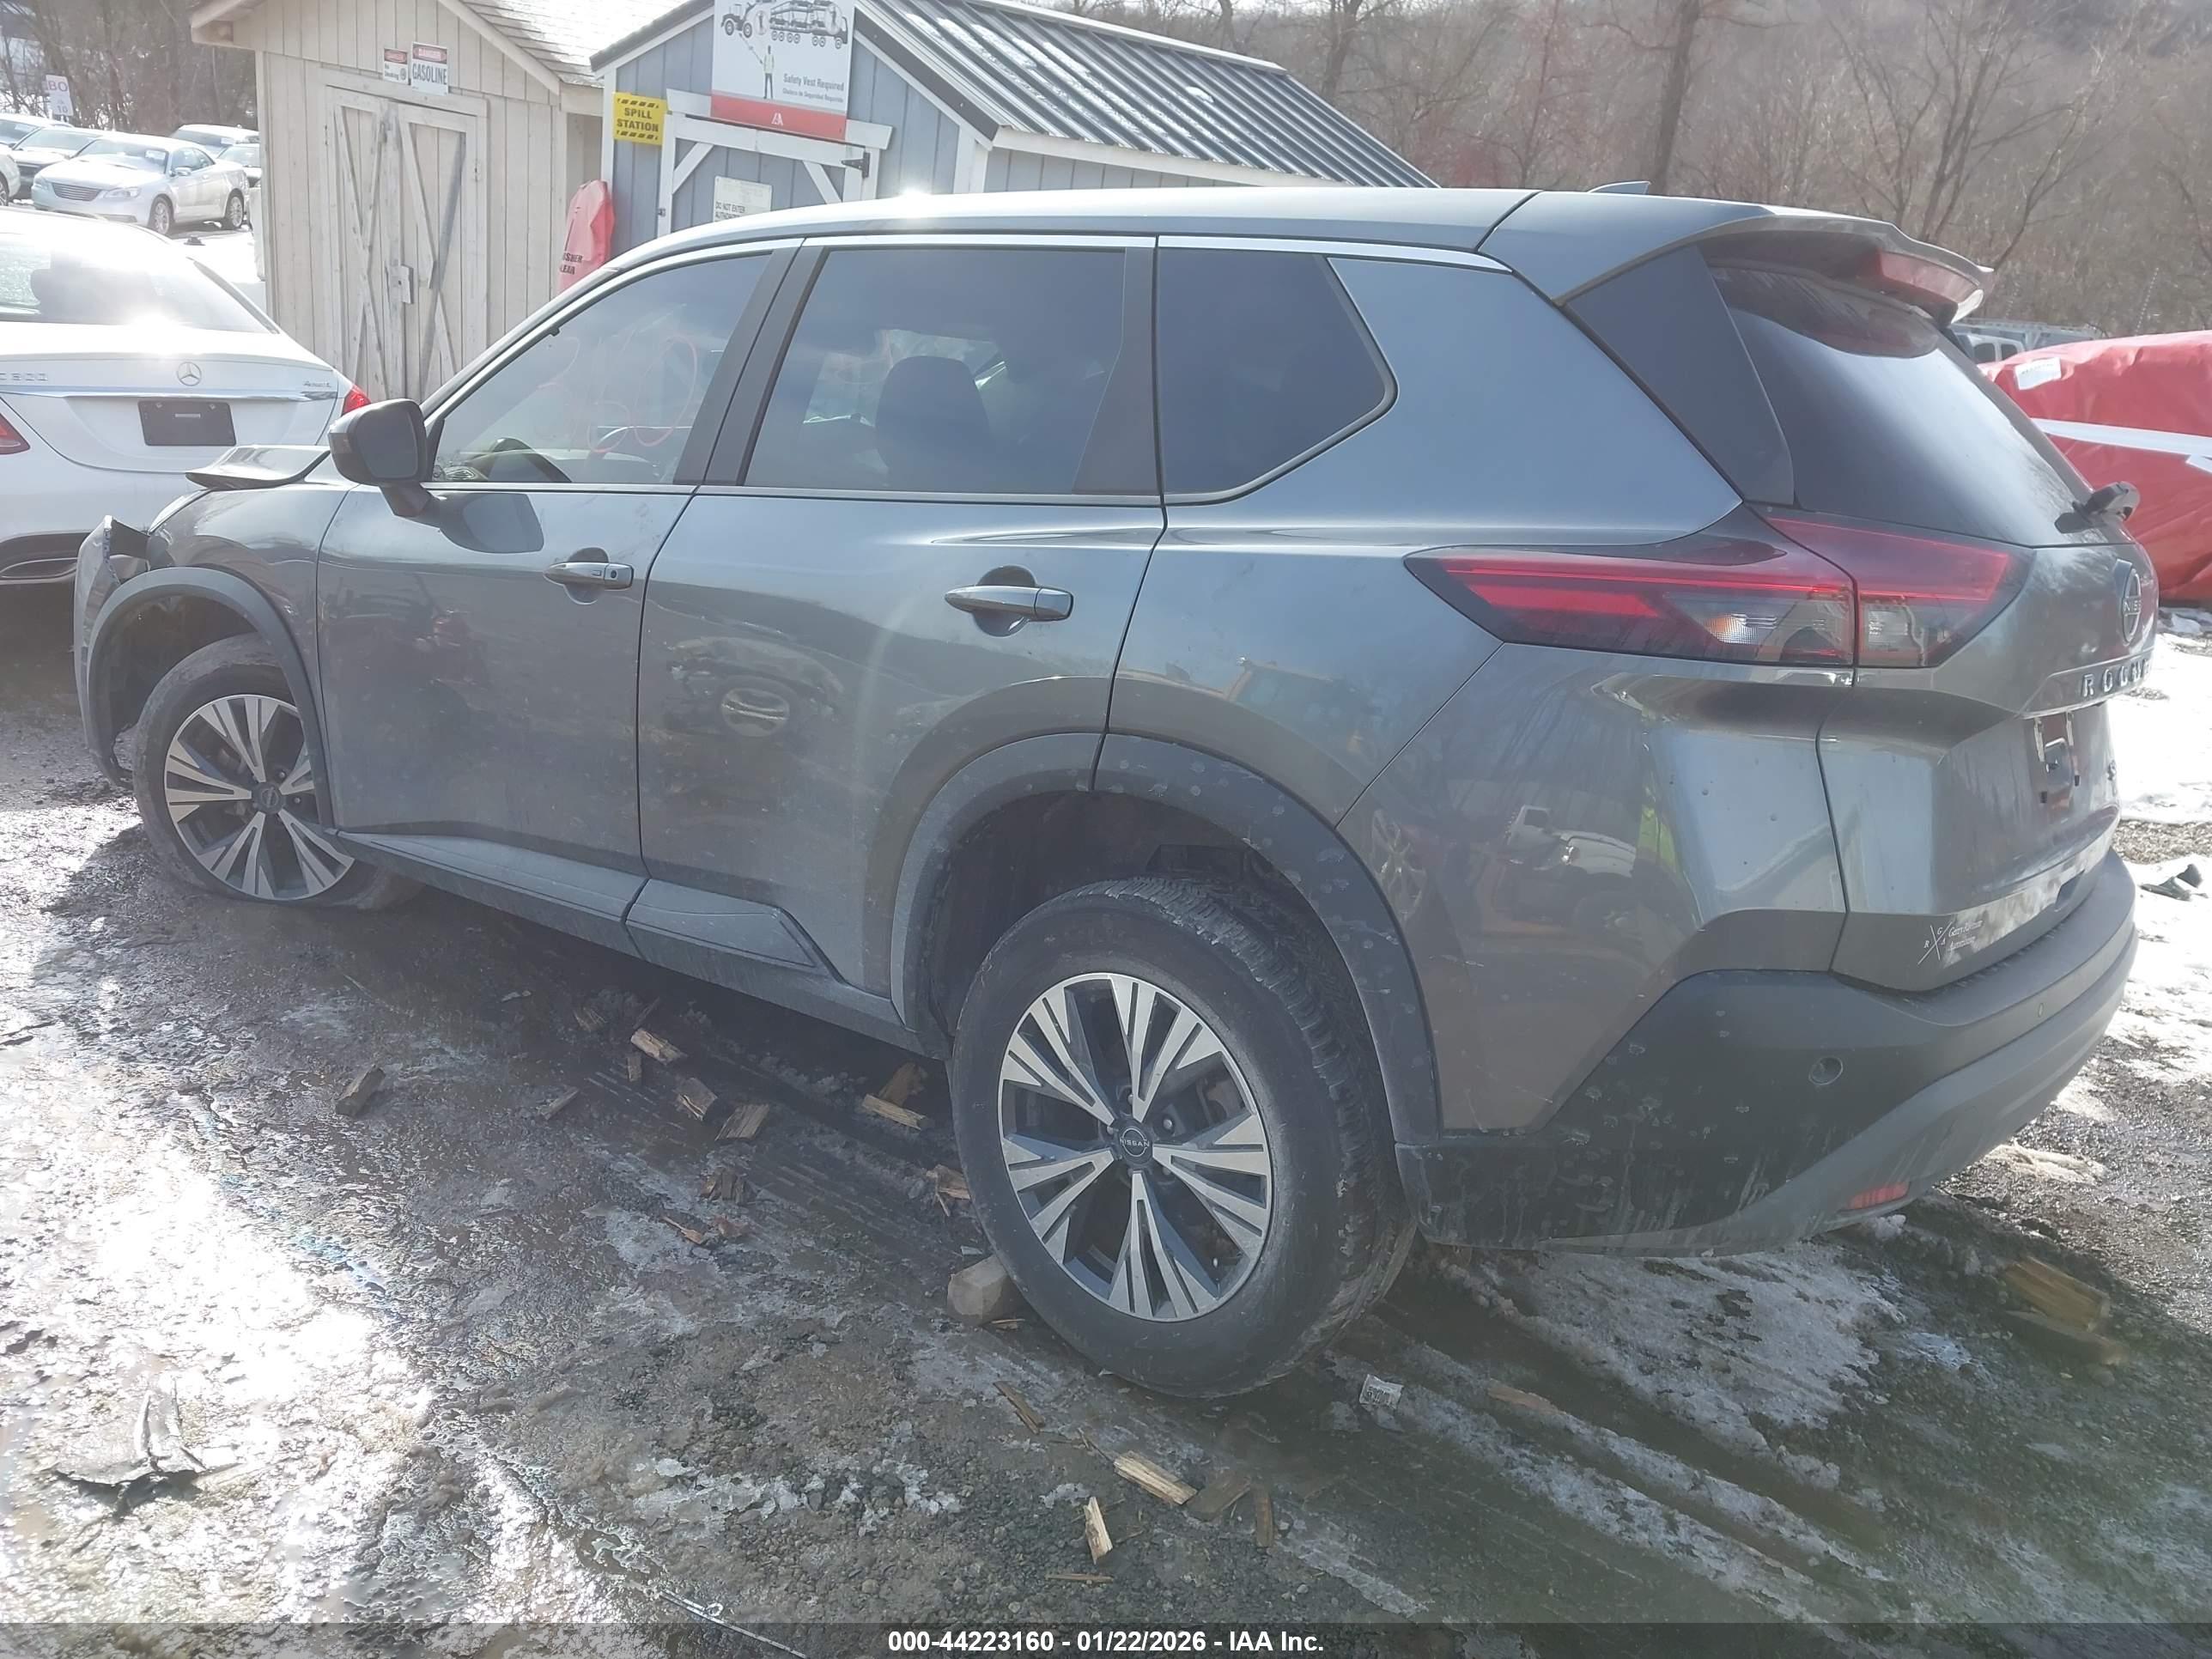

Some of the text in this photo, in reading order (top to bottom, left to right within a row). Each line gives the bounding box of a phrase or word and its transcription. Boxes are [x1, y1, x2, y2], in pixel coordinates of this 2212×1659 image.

[412, 63, 447, 85] GASOLINE
[783, 73, 845, 91] Safety Vest Required
[624, 107, 653, 119] SPILL
[617, 118, 659, 132] STATION
[1119, 1137, 1150, 1147] NISSAN
